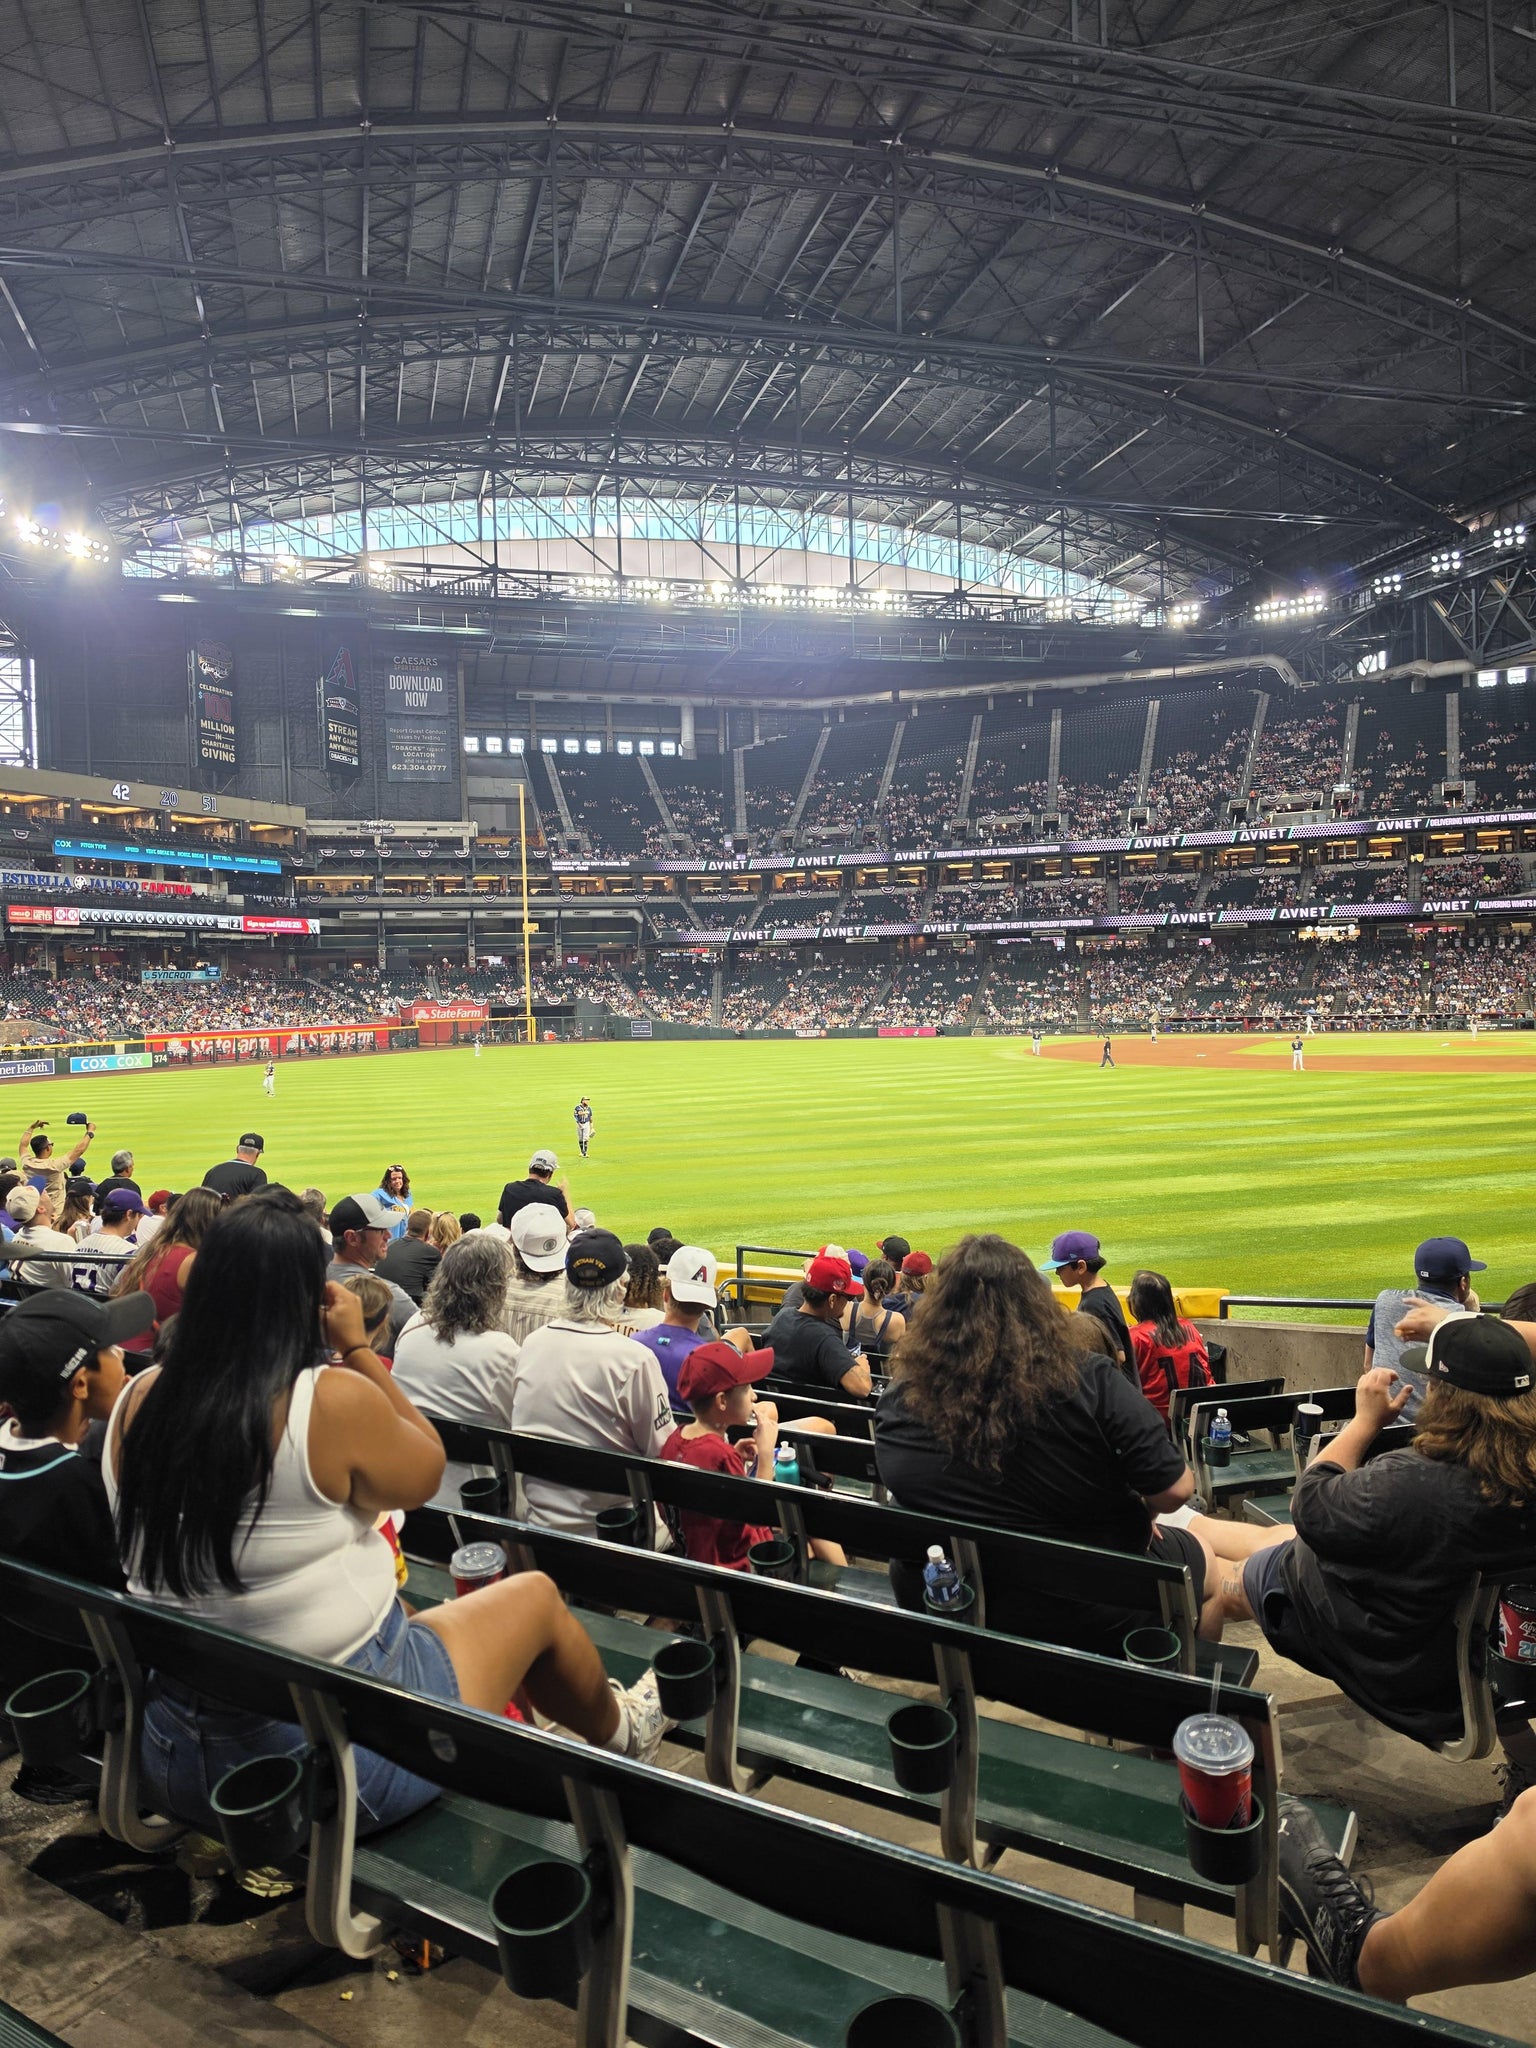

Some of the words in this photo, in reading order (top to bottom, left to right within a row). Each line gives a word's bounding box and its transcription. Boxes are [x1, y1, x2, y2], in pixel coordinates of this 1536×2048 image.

[393, 656, 438, 666] CAESARS
[393, 664, 430, 672] SPORTSBOOK
[389, 675, 443, 692] DOWNLOAD
[199, 683, 233, 697] CELEBRATING
[405, 692, 428, 707] NOW
[200, 719, 235, 735] MILLION
[328, 723, 358, 738] STREAM
[215, 733, 222, 741] IN
[328, 734, 341, 743] ANY
[342, 737, 358, 747] GAME
[201, 739, 235, 751] CHARITABLE
[328, 743, 358, 755] ANYWHERE
[201, 748, 236, 763] GIVING
[391, 764, 447, 772] 623.304.0777
[112, 783, 130, 801] 42
[160, 791, 178, 807] 20
[201, 796, 218, 813] 51
[1376, 818, 1423, 831] AVNET
[1430, 818, 1463, 827] DELIVERING
[1463, 815, 1486, 825] WHAT'S
[1486, 814, 1501, 823] NEXT
[1239, 829, 1287, 841] AVNET
[55, 840, 72, 848] COX
[1134, 836, 1180, 849] AVNET
[894, 851, 930, 861] AVNET
[937, 850, 963, 858] DELIVERING
[963, 849, 980, 857] WHAT'S
[998, 847, 1028, 856] TECHNOLOGY
[1028, 845, 1060, 854] DISTRIBUTION
[708, 860, 747, 871] AVNET
[797, 855, 836, 867] AVNET
[2, 872, 72, 888] ESTRELLA
[89, 878, 139, 891] JALISCO
[141, 882, 192, 895] CANTINA
[1279, 906, 1329, 918] AVNET
[1422, 900, 1470, 912] AVNET
[232, 919, 238, 928] 2
[1170, 912, 1216, 924] AVNET
[922, 923, 959, 933] AVNET
[966, 922, 992, 931] DELIVERING
[993, 921, 1010, 930] WHAT'S
[1011, 921, 1022, 929] NEXT
[1029, 920, 1059, 928] TECHNOLOGY
[1060, 919, 1093, 927] DISTRIBUTION
[732, 930, 772, 941] AVNET
[822, 927, 862, 938] AVNET
[151, 971, 191, 980] SYNCRON
[430, 1008, 456, 1019] State
[456, 1008, 481, 1018] Farm
[81, 1057, 109, 1070] COX
[116, 1055, 143, 1068] COX
[154, 1053, 167, 1064] 374
